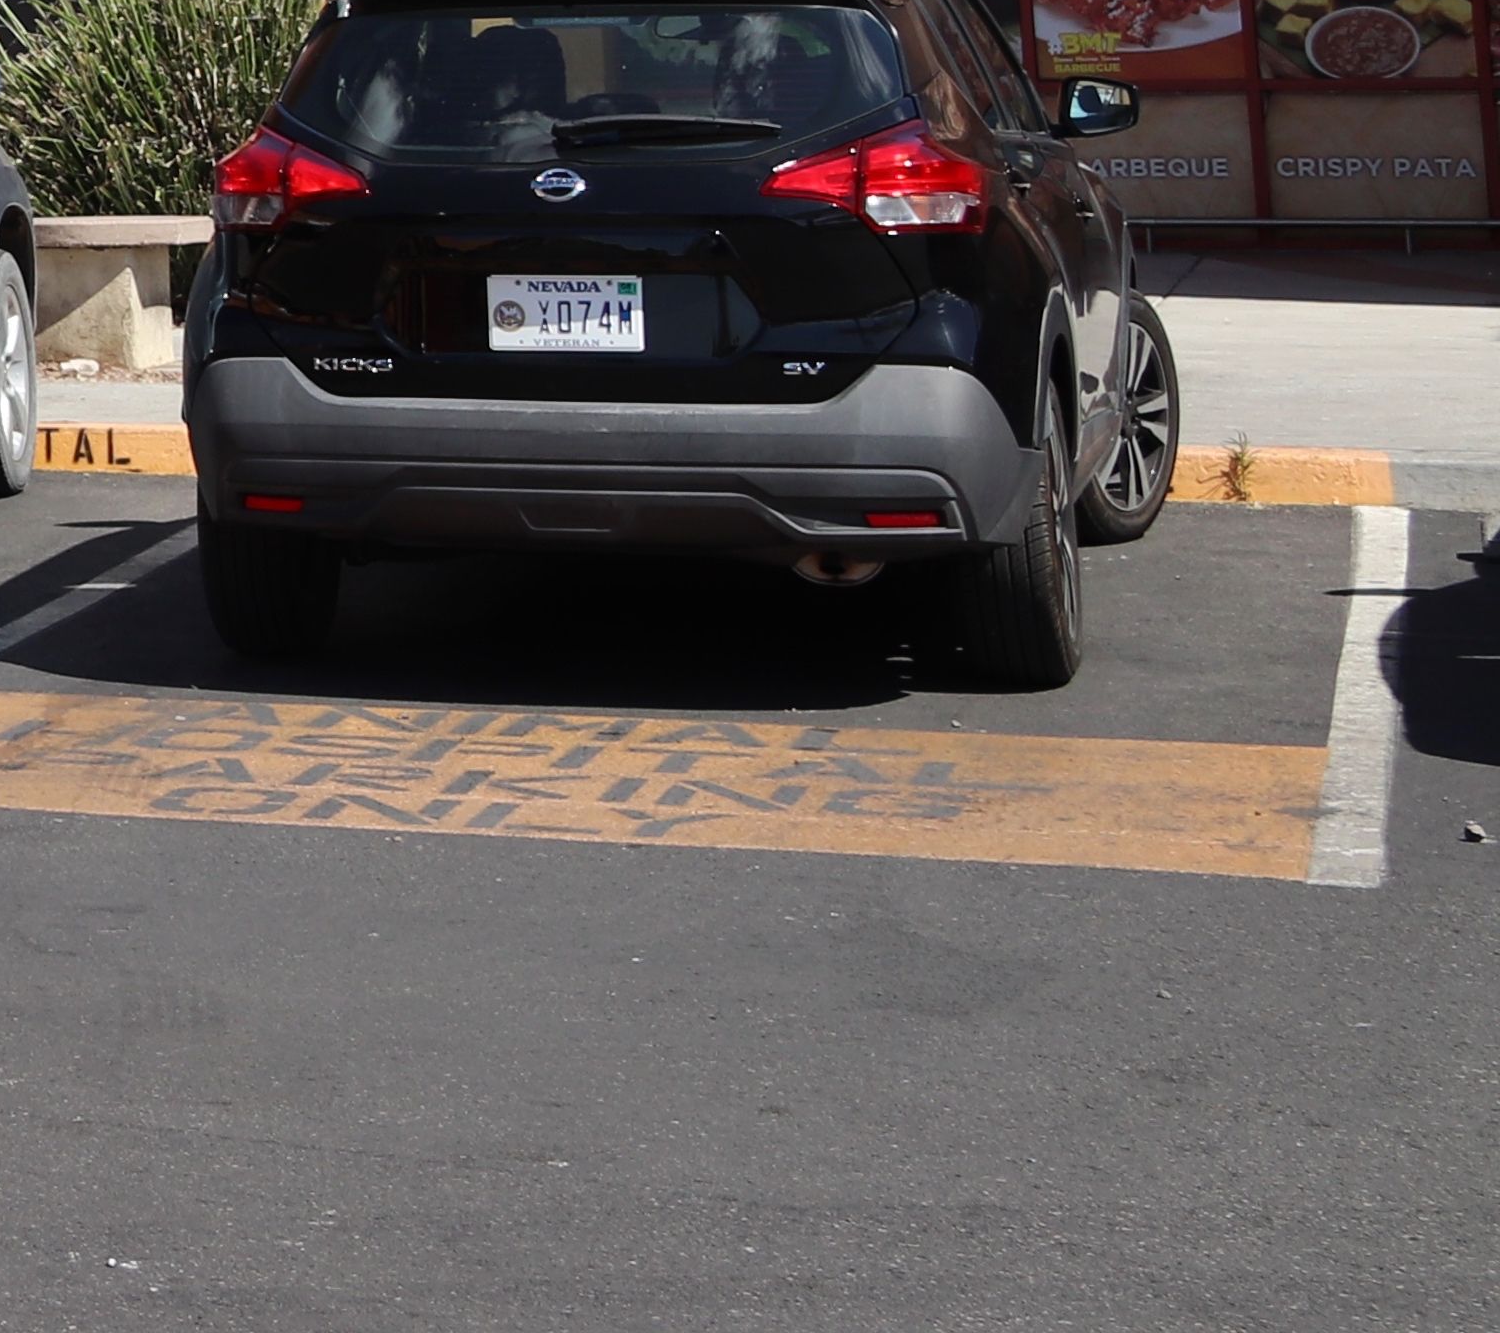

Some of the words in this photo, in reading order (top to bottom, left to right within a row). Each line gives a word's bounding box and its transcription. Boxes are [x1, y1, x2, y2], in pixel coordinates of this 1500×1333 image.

[1276, 157, 1383, 178] CRISPY
[1394, 157, 1476, 178] PATA
[527, 281, 602, 293] NEVADA
[533, 339, 600, 347] VETERAN
[313, 357, 393, 372] KICKS
[783, 362, 825, 375] SV
[156, 702, 919, 756] ANIMAL
[149, 786, 737, 837] ONLY
